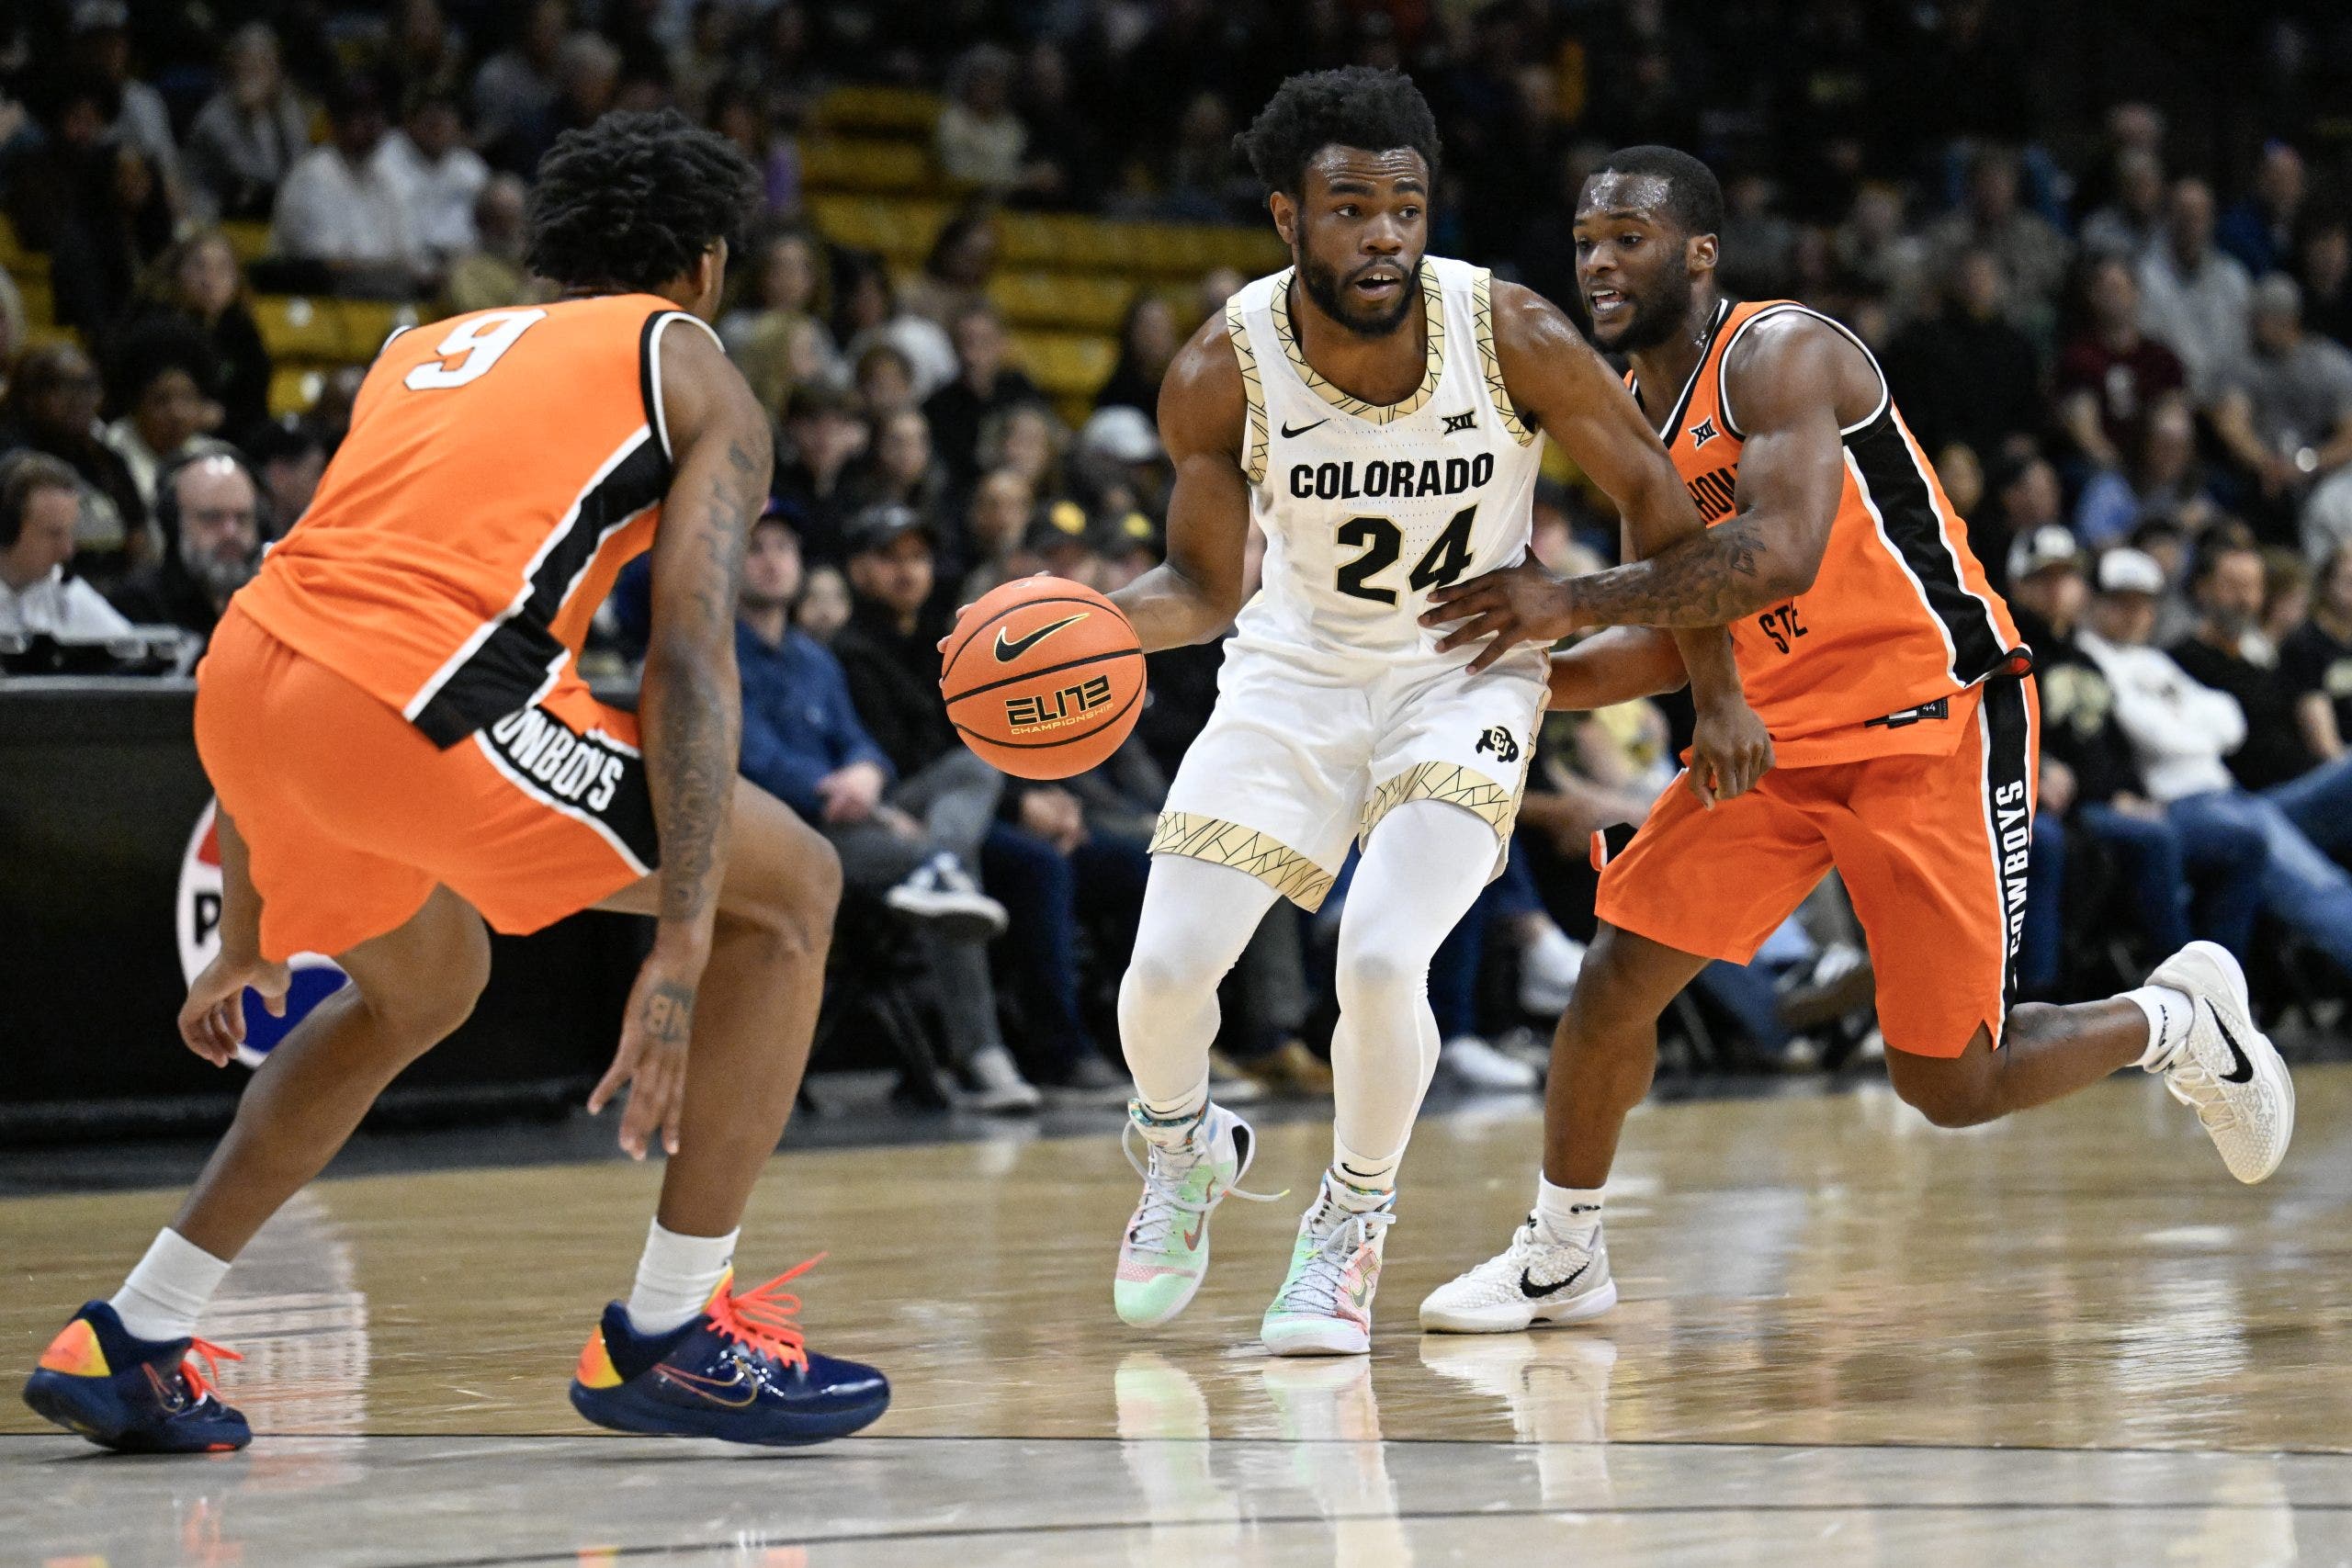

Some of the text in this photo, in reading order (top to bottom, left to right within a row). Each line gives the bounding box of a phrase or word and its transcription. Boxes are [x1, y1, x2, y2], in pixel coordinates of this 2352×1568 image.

[402, 309, 548, 390] 9
[1290, 452, 1495, 500] COLORADO
[1335, 502, 1480, 610] 24
[1005, 674, 1112, 727] ELITE
[1011, 703, 1114, 734] CHAMPIONSHIP
[1922, 702, 1936, 712] 44
[492, 708, 625, 812] OWBOYS
